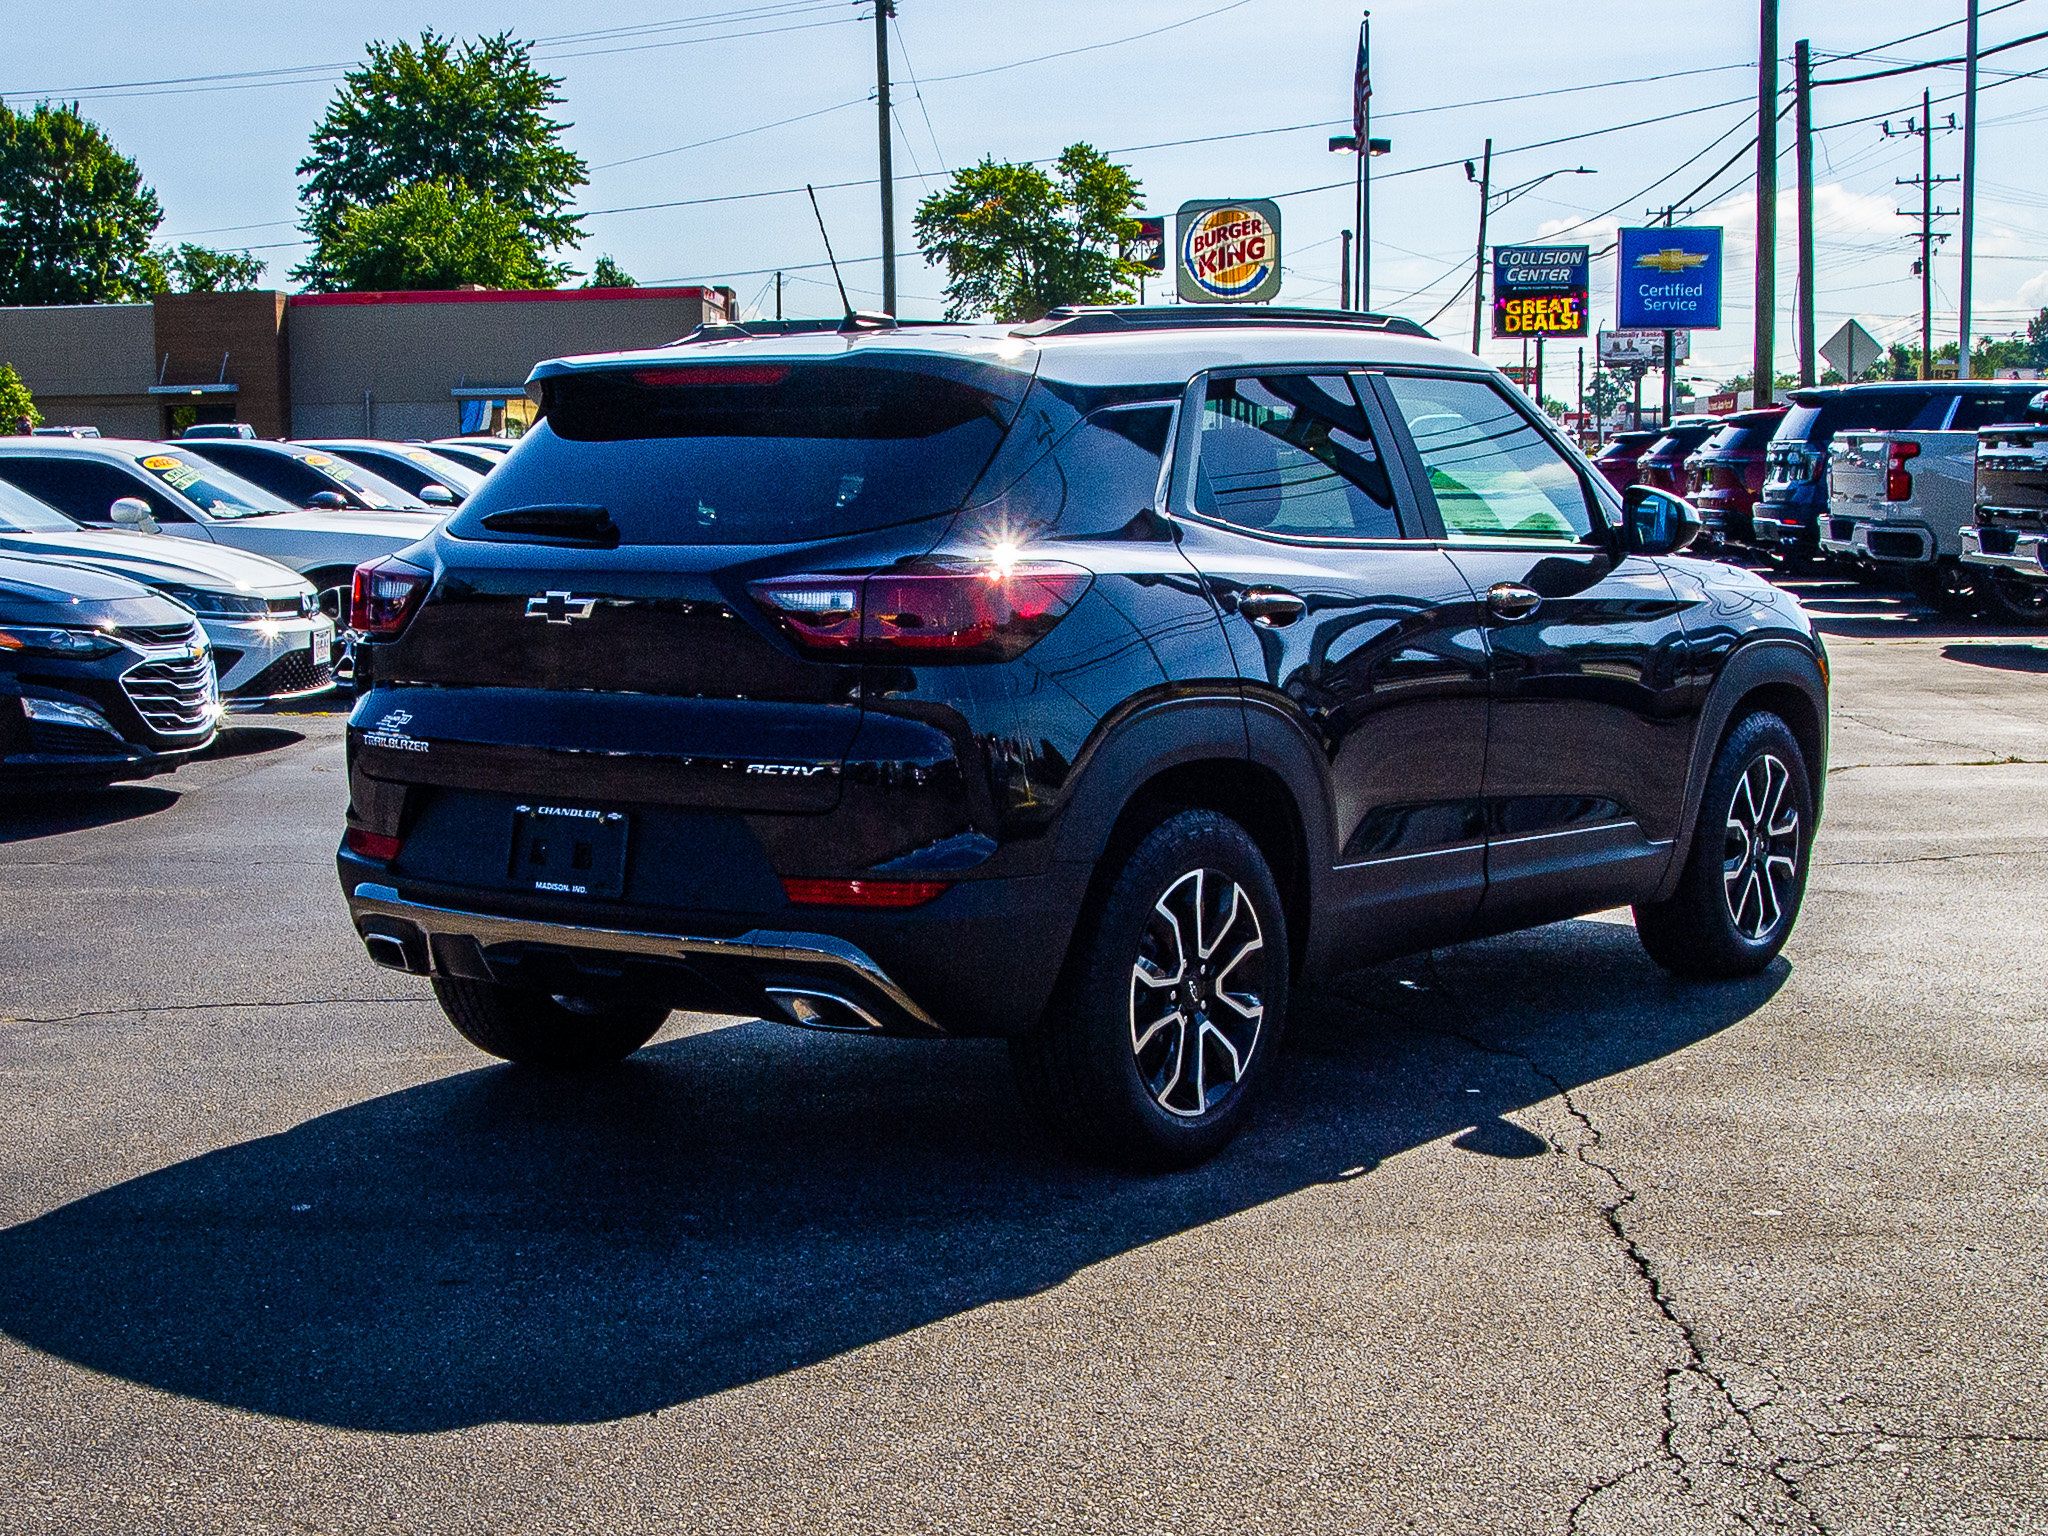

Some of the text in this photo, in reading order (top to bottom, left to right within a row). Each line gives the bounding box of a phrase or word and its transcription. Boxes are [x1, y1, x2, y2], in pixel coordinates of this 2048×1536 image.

[1194, 219, 1262, 254] BURGER
[1199, 236, 1266, 278] KING
[1498, 251, 1582, 266] COLLISION
[1506, 268, 1570, 282] CENTER
[1638, 283, 1703, 297] Certified
[1506, 298, 1573, 316] GREAT
[1643, 298, 1697, 311] Service
[1505, 313, 1579, 333] DEALS!
[363, 734, 429, 752] TRAILBLAZER
[746, 764, 824, 776] ACTIV
[538, 806, 600, 818] CHANDLER
